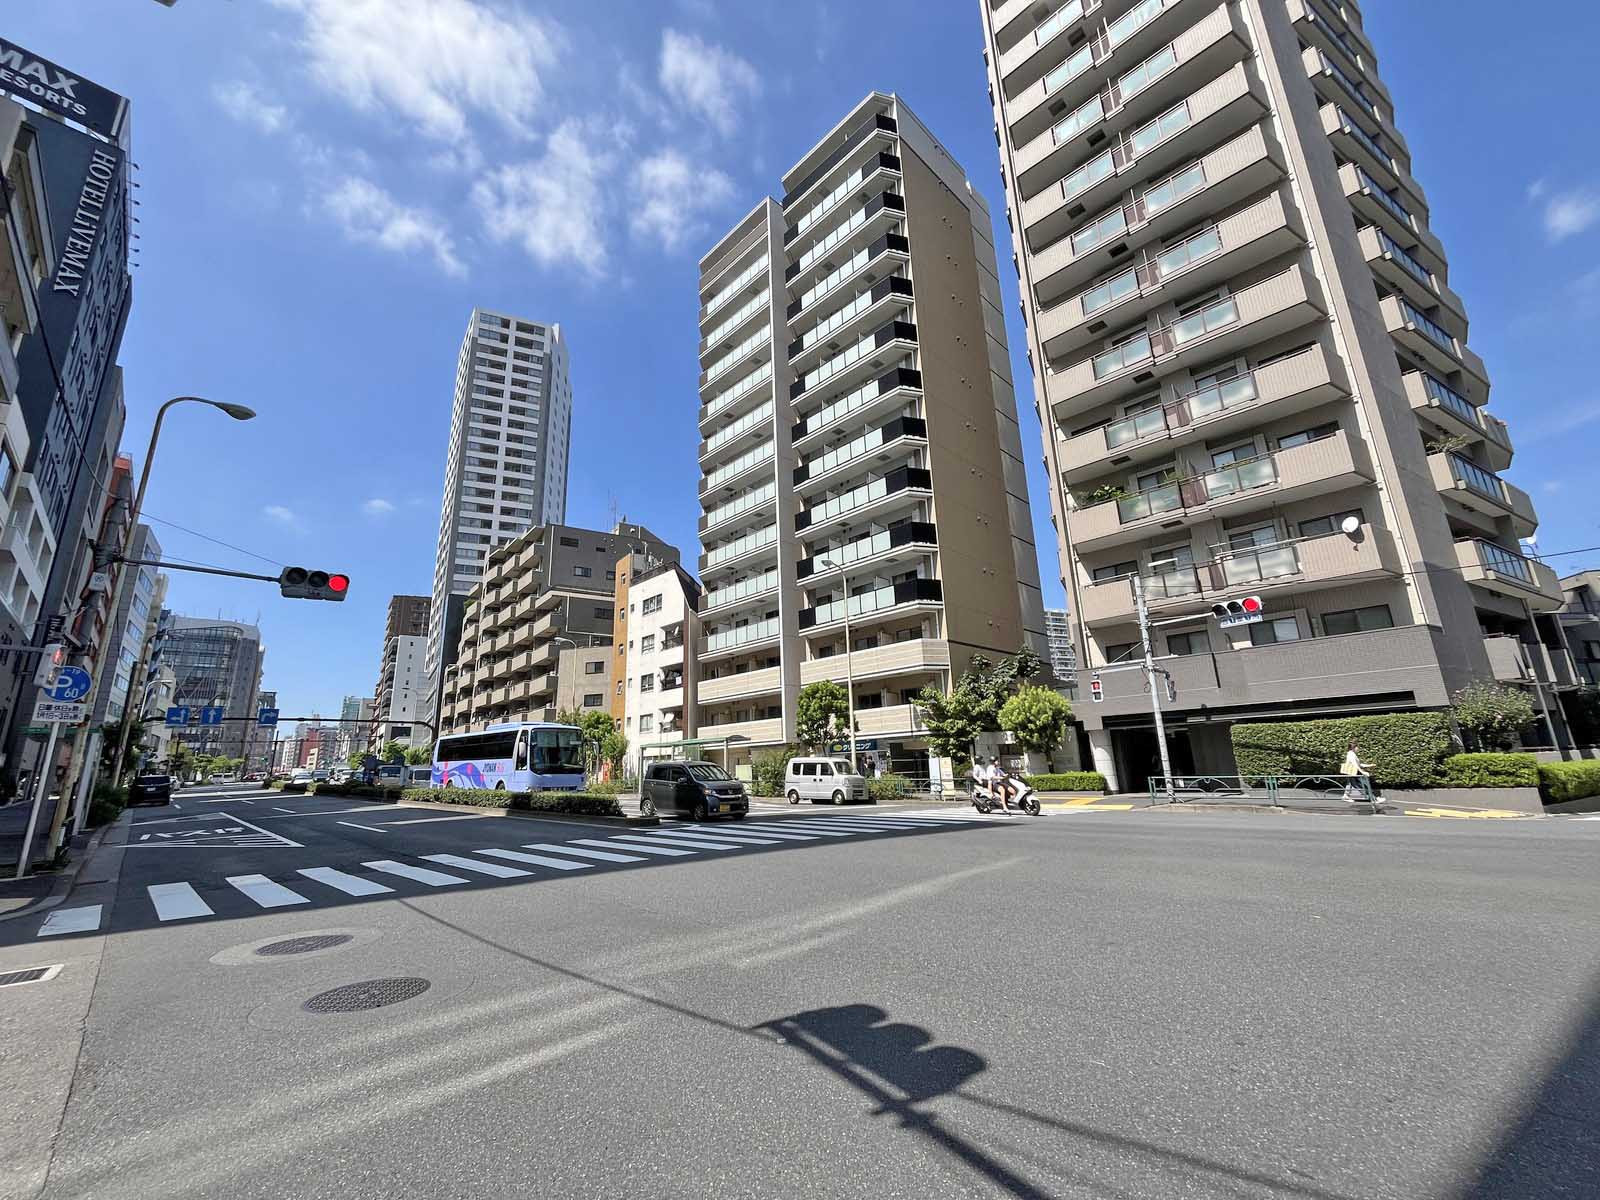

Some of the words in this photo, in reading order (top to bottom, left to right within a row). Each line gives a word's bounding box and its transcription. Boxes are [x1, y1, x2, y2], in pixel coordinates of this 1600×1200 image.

[0, 68, 87, 115] ESORTS
[80, 149, 116, 209] HOTEL
[50, 675, 73, 697] P
[64, 688, 79, 698] 60
